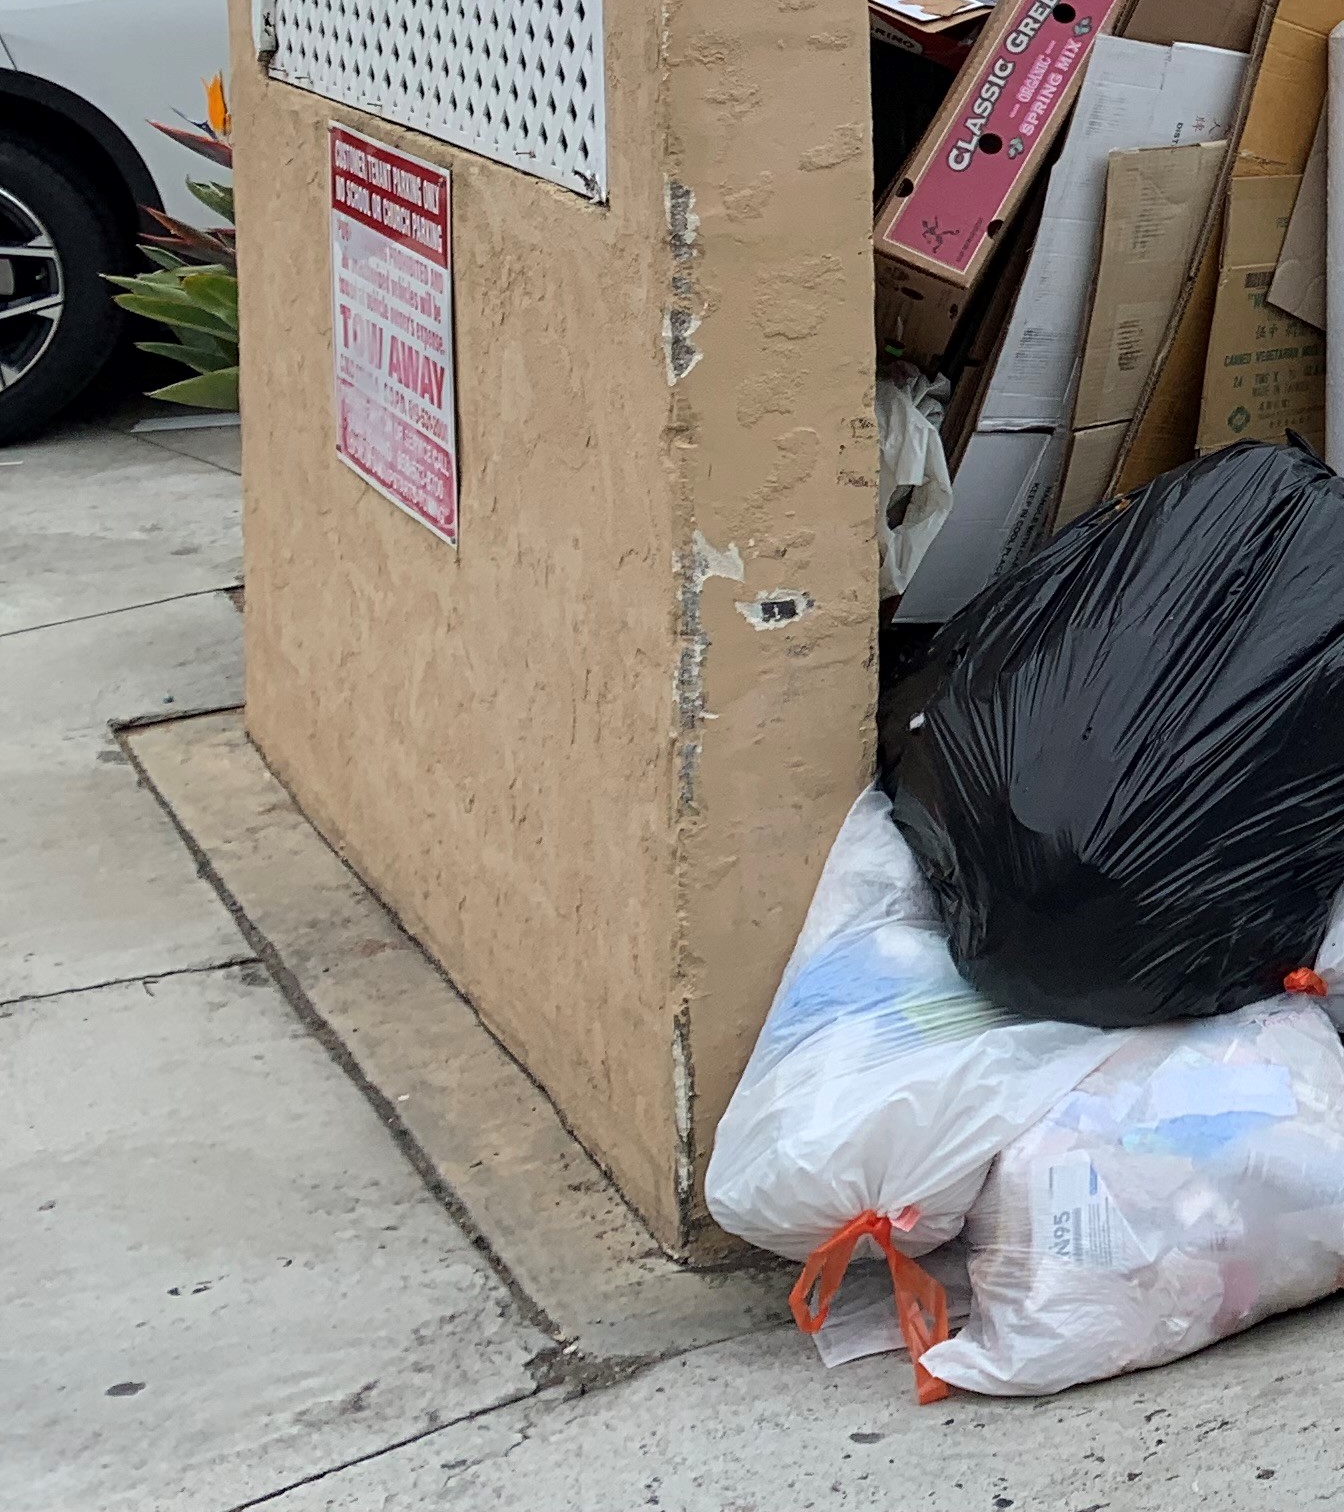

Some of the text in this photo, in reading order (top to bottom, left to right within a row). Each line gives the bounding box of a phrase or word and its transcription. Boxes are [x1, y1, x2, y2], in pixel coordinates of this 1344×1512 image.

[870, 26, 915, 49] RINO
[1016, 54, 1052, 103] ORGANIC
[1019, 38, 1082, 137] SPRING MIX
[948, 58, 1016, 172] CLASSIC
[1170, 122, 1184, 146] DIST
[335, 139, 440, 215] CUSTOMER TENANT PARKING ONLY
[335, 174, 346, 203] NO
[346, 179, 371, 217] SCHOOL
[371, 192, 383, 223] OR
[382, 197, 412, 237] CHURCH
[412, 211, 443, 254] PARKING
[419, 290, 432, 318] will
[432, 295, 442, 325] be
[339, 303, 384, 370] TOW
[388, 334, 446, 411] AWAY
[1224, 352, 1252, 368] CANNED
[1255, 347, 1299, 364] VEGETARIAN
[1026, 482, 1041, 508] KEEP
[1007, 520, 1024, 546] COOL
